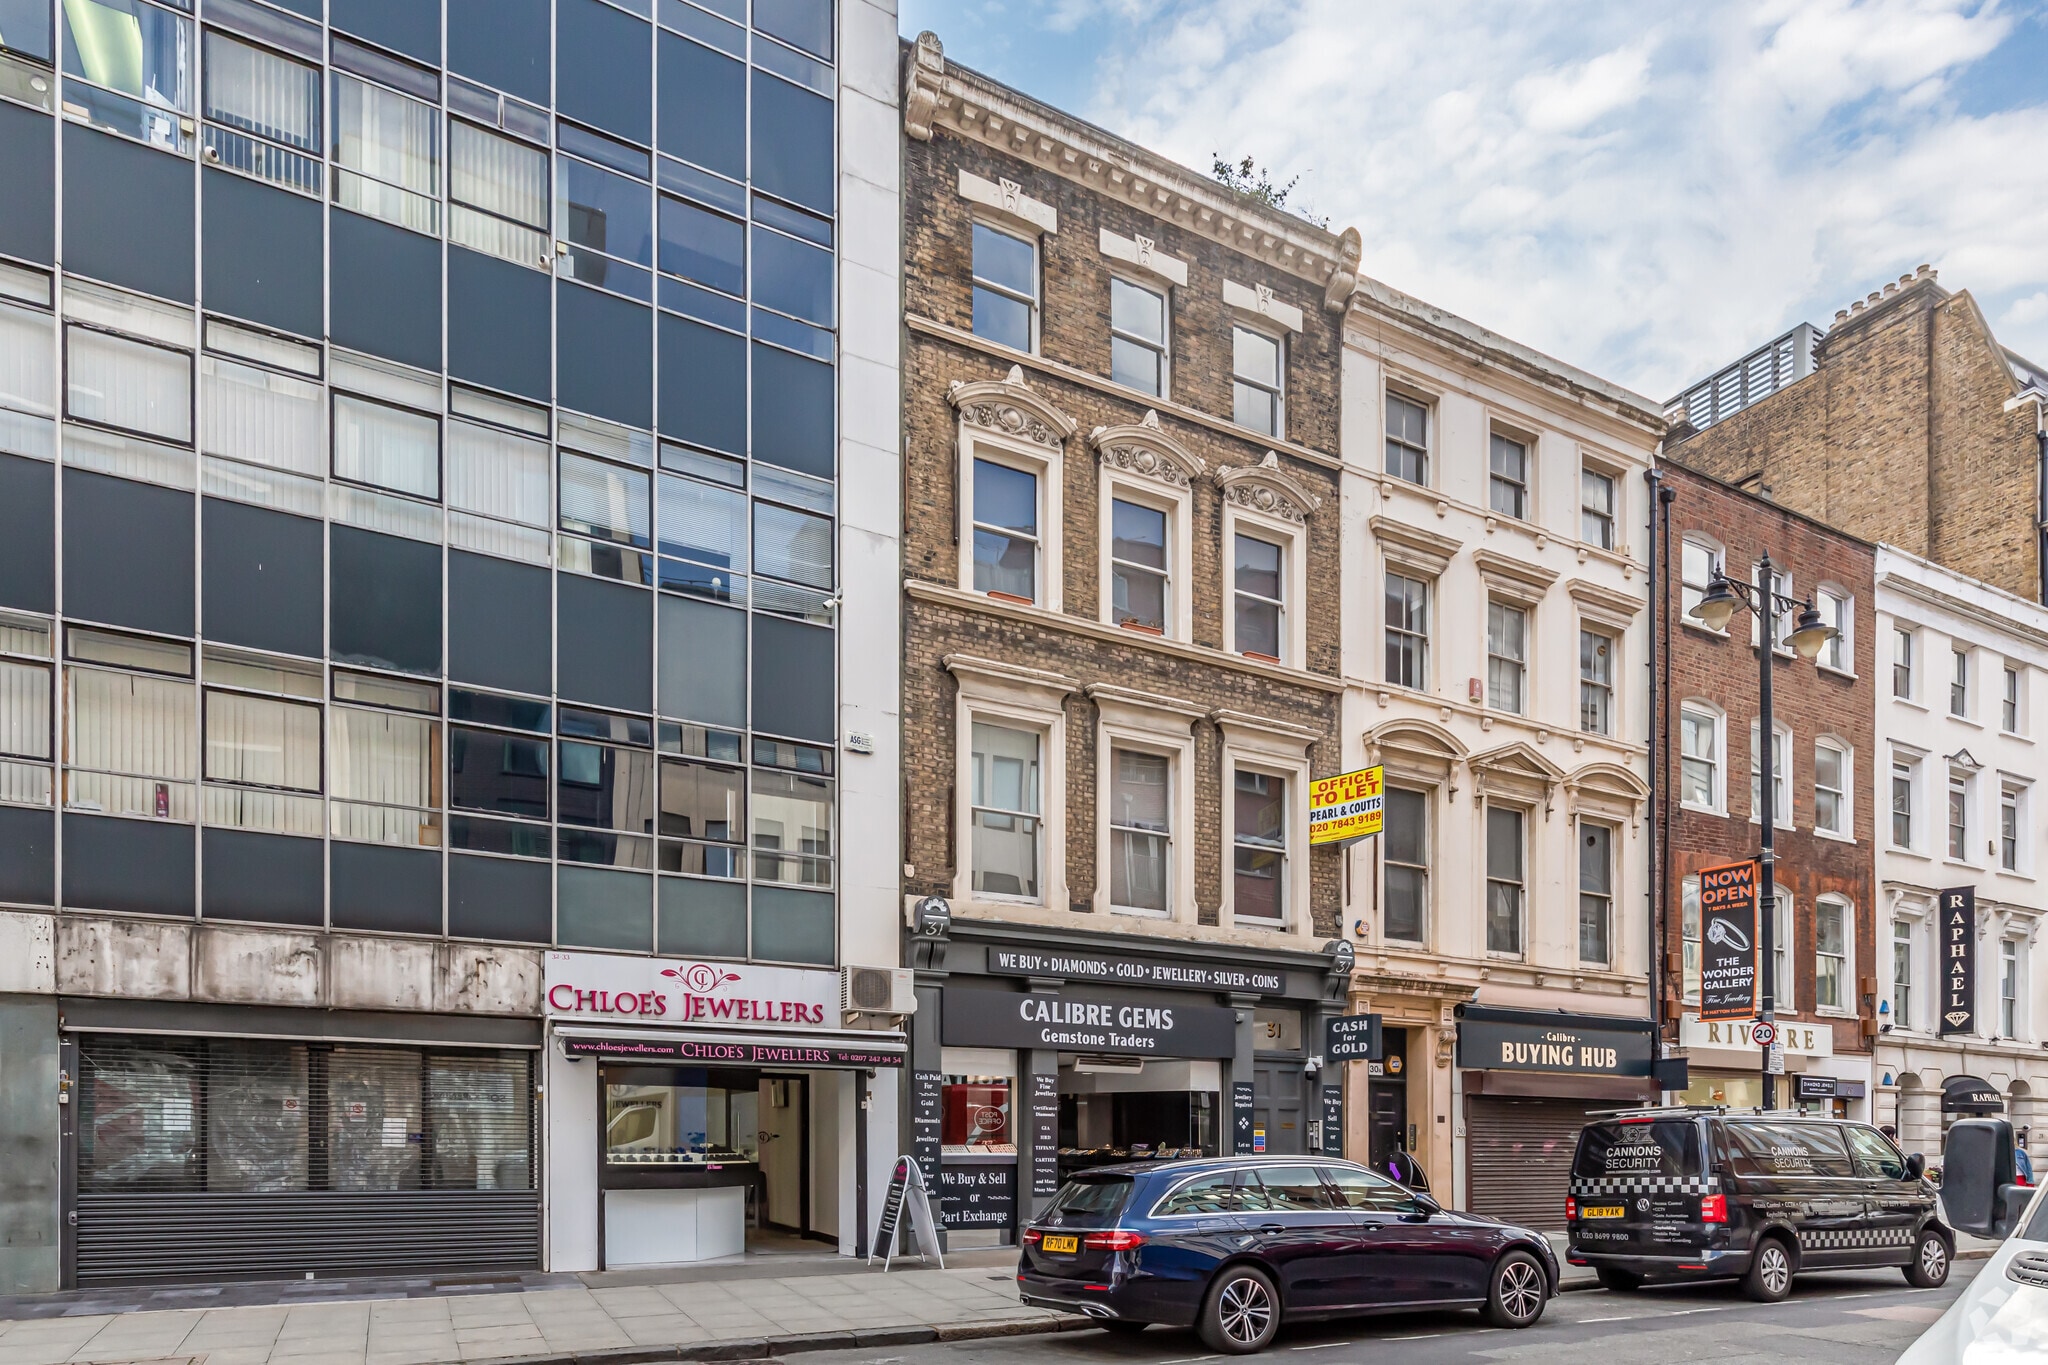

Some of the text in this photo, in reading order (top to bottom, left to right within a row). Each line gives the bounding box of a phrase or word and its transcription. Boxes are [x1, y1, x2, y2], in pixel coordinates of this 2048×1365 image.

[850, 736, 861, 744] ASG
[1318, 770, 1374, 793] OFFICE
[1312, 781, 1379, 806] TO LET
[1310, 797, 1381, 822] PEARL & COUTTS
[1310, 822, 1328, 833] 020
[1332, 818, 1355, 830] 7843
[1358, 812, 1381, 824] 9189
[1704, 868, 1752, 888] NOW
[1702, 884, 1753, 904] OPEN
[926, 922, 944, 936] 31
[1950, 895, 1966, 1007] RAPHAEL
[1336, 960, 1351, 973] 31
[1716, 957, 1740, 967] THE
[999, 953, 1279, 989] WE BUY DIAMONDS GOLD JEWELLERY SILVER COINS
[1703, 966, 1754, 979] WONDER
[1704, 978, 1753, 990] GALLERY
[549, 984, 824, 1023] CHLOE'S JEWELLERS
[1704, 993, 1751, 1004] Fine Jewellery
[1020, 999, 1174, 1030] CALIBRE GEMS
[1267, 1022, 1282, 1038] 31
[1332, 1020, 1368, 1033] CASH
[1041, 1028, 1155, 1048] Gemstone Traders
[1546, 1032, 1576, 1043] Calibre
[1756, 1029, 1772, 1039] 20
[572, 1042, 674, 1054] www.chloesjewellers.com
[681, 1043, 744, 1058] CHLOE'S
[752, 1046, 830, 1062] JEWELLERS
[850, 1054, 867, 1062] 0207
[868, 1055, 881, 1063] 242
[893, 1056, 902, 1064] 54
[1332, 1043, 1368, 1054] GOLD
[1502, 1042, 1617, 1068] BUYING HUB
[916, 1073, 928, 1081] Cash
[1973, 1094, 2002, 1103] RAPHAEL
[1606, 1146, 1661, 1157] CANNONS
[1771, 1146, 1809, 1157] CANNONS
[1606, 1158, 1661, 1169] SECURITY
[1774, 1158, 1811, 1168] SECURITY
[942, 1172, 1006, 1187] We Buy & Sell
[970, 1194, 980, 1202] or
[940, 1210, 1008, 1223] Part Exchange
[1606, 1208, 1620, 1216] YAK
[1595, 1232, 1610, 1240] 8699
[1046, 1238, 1062, 1249] RF70
